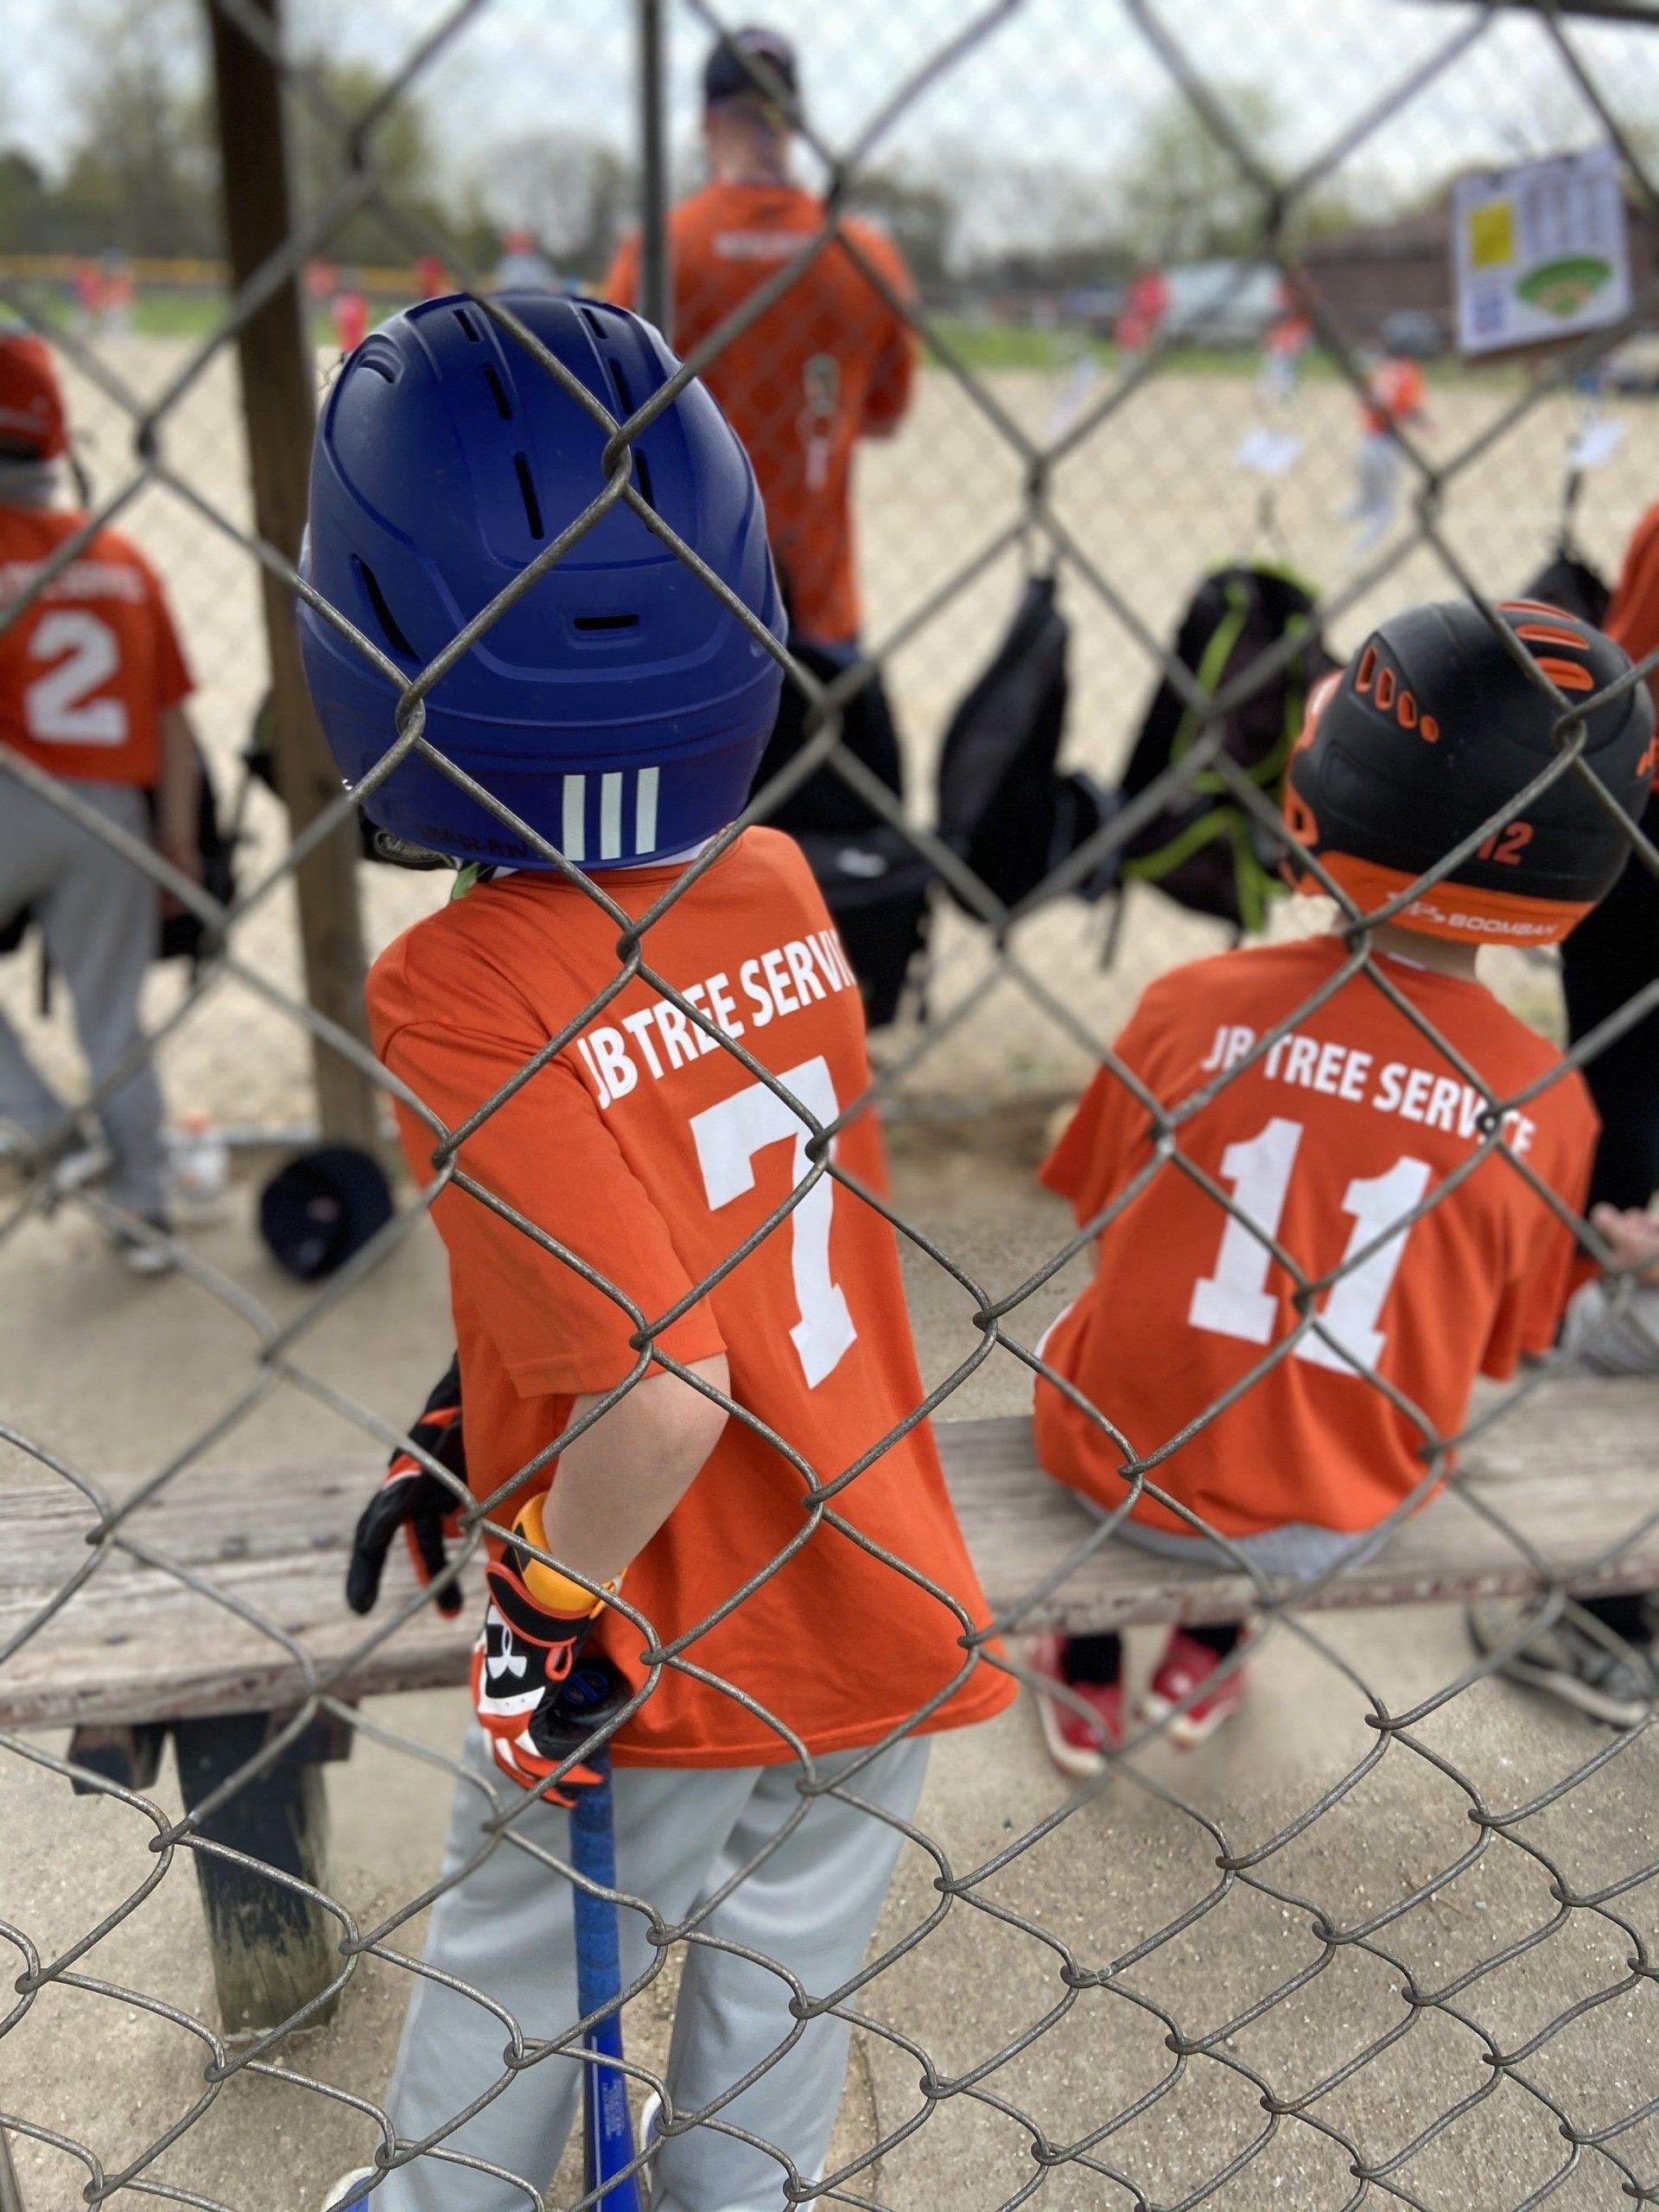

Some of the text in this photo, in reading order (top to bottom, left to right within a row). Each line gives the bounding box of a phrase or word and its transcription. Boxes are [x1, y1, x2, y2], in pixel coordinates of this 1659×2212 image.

[25, 609, 127, 746] 2
[577, 1026, 639, 1110] JB
[621, 971, 746, 1080] TREE
[1262, 1028, 1374, 1103] TREE
[689, 1054, 859, 1390] 7
[1186, 1116, 1433, 1380] 11
